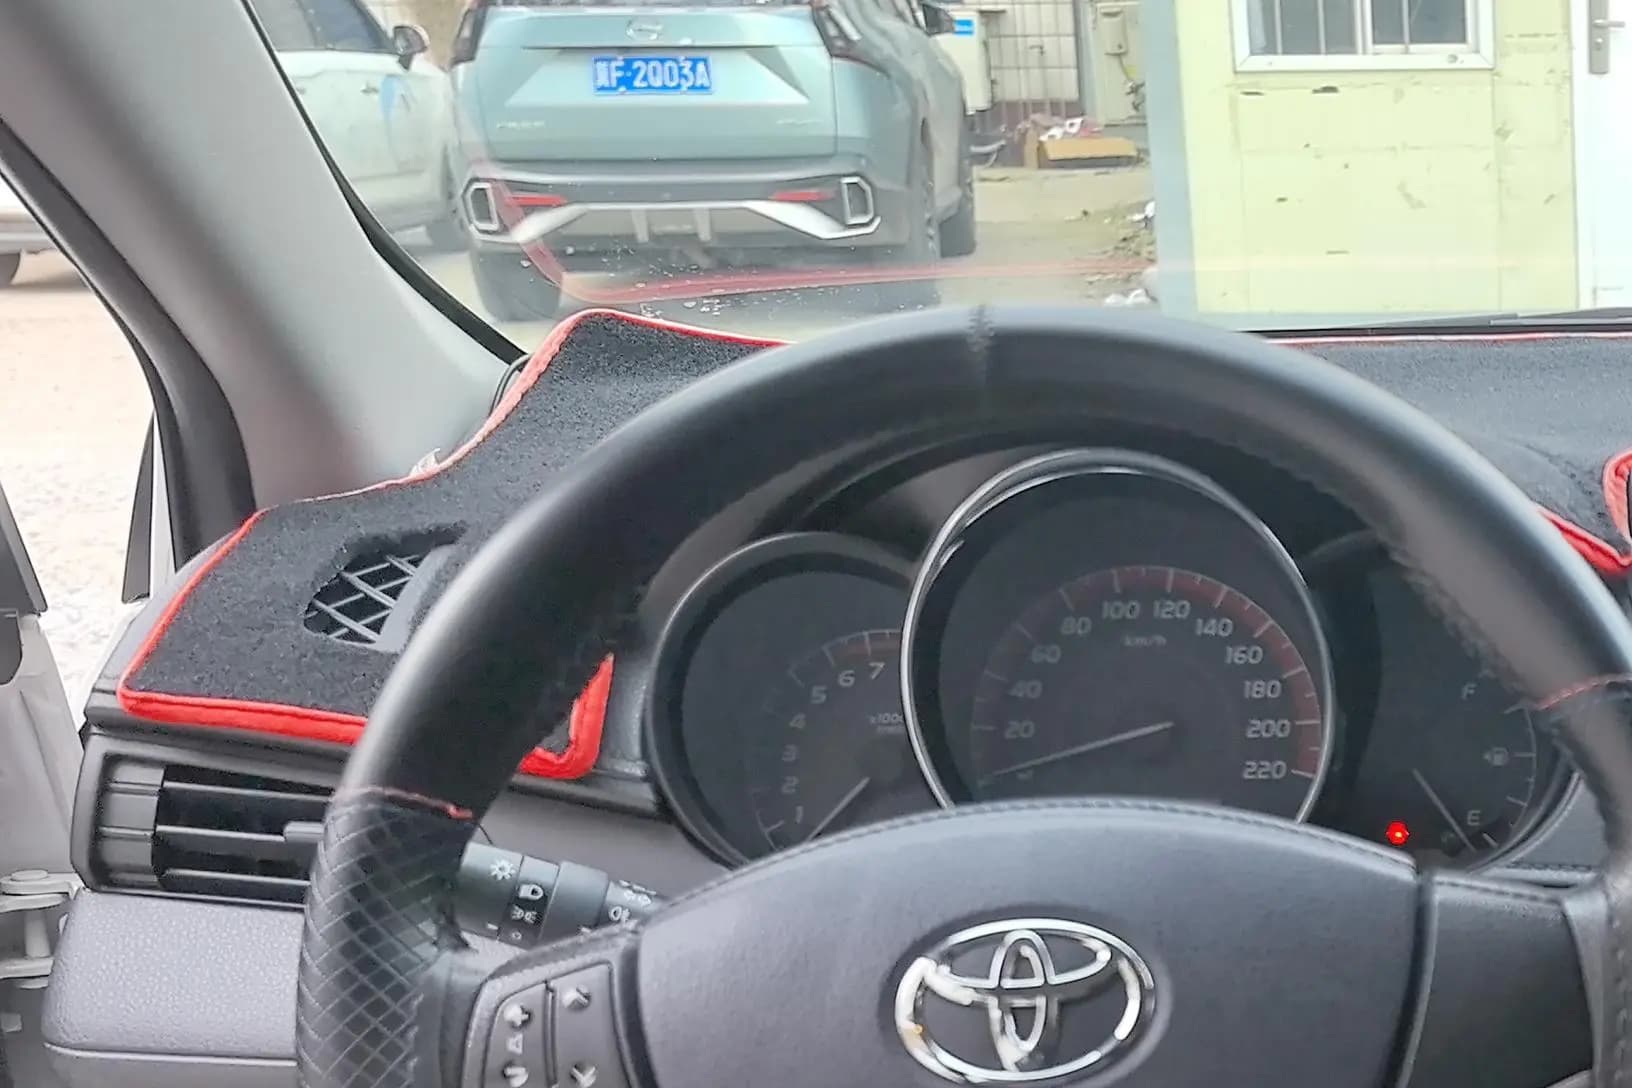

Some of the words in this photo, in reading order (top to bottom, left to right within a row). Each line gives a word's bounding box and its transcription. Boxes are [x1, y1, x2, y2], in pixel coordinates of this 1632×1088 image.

[1102, 601, 1140, 619] 100
[1153, 600, 1190, 619] 120
[1061, 616, 1092, 636] 80
[1195, 618, 1233, 637] 140
[1225, 645, 1263, 664] 160
[838, 669, 856, 687] 6
[868, 661, 886, 680] 7
[811, 685, 827, 704] 5
[1244, 680, 1282, 698] 180
[1005, 719, 1035, 739] 20
[1246, 719, 1291, 738] 200
[1243, 760, 1287, 779] 220
[1466, 810, 1482, 826] E
